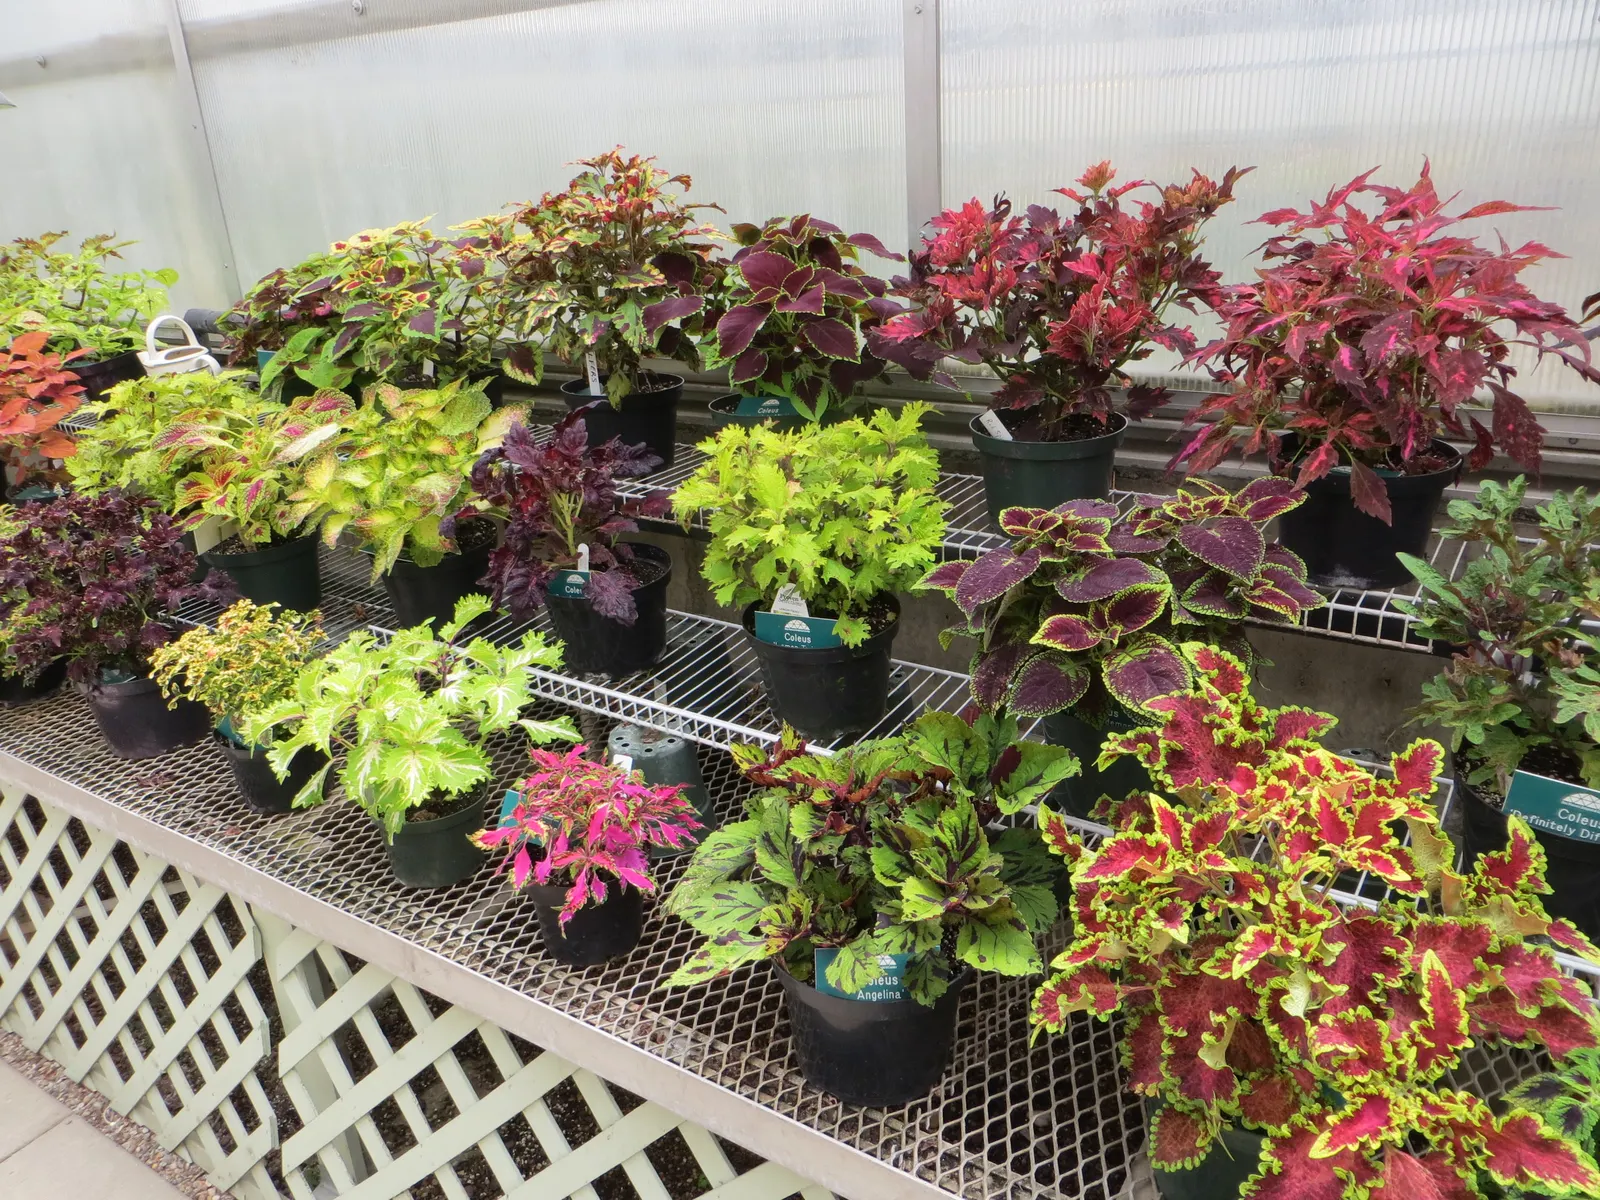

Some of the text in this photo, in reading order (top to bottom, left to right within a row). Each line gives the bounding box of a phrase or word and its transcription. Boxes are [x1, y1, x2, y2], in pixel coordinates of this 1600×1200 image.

[564, 585, 583, 594] Cole
[784, 632, 812, 644] Coleus
[865, 976, 899, 986] oleus
